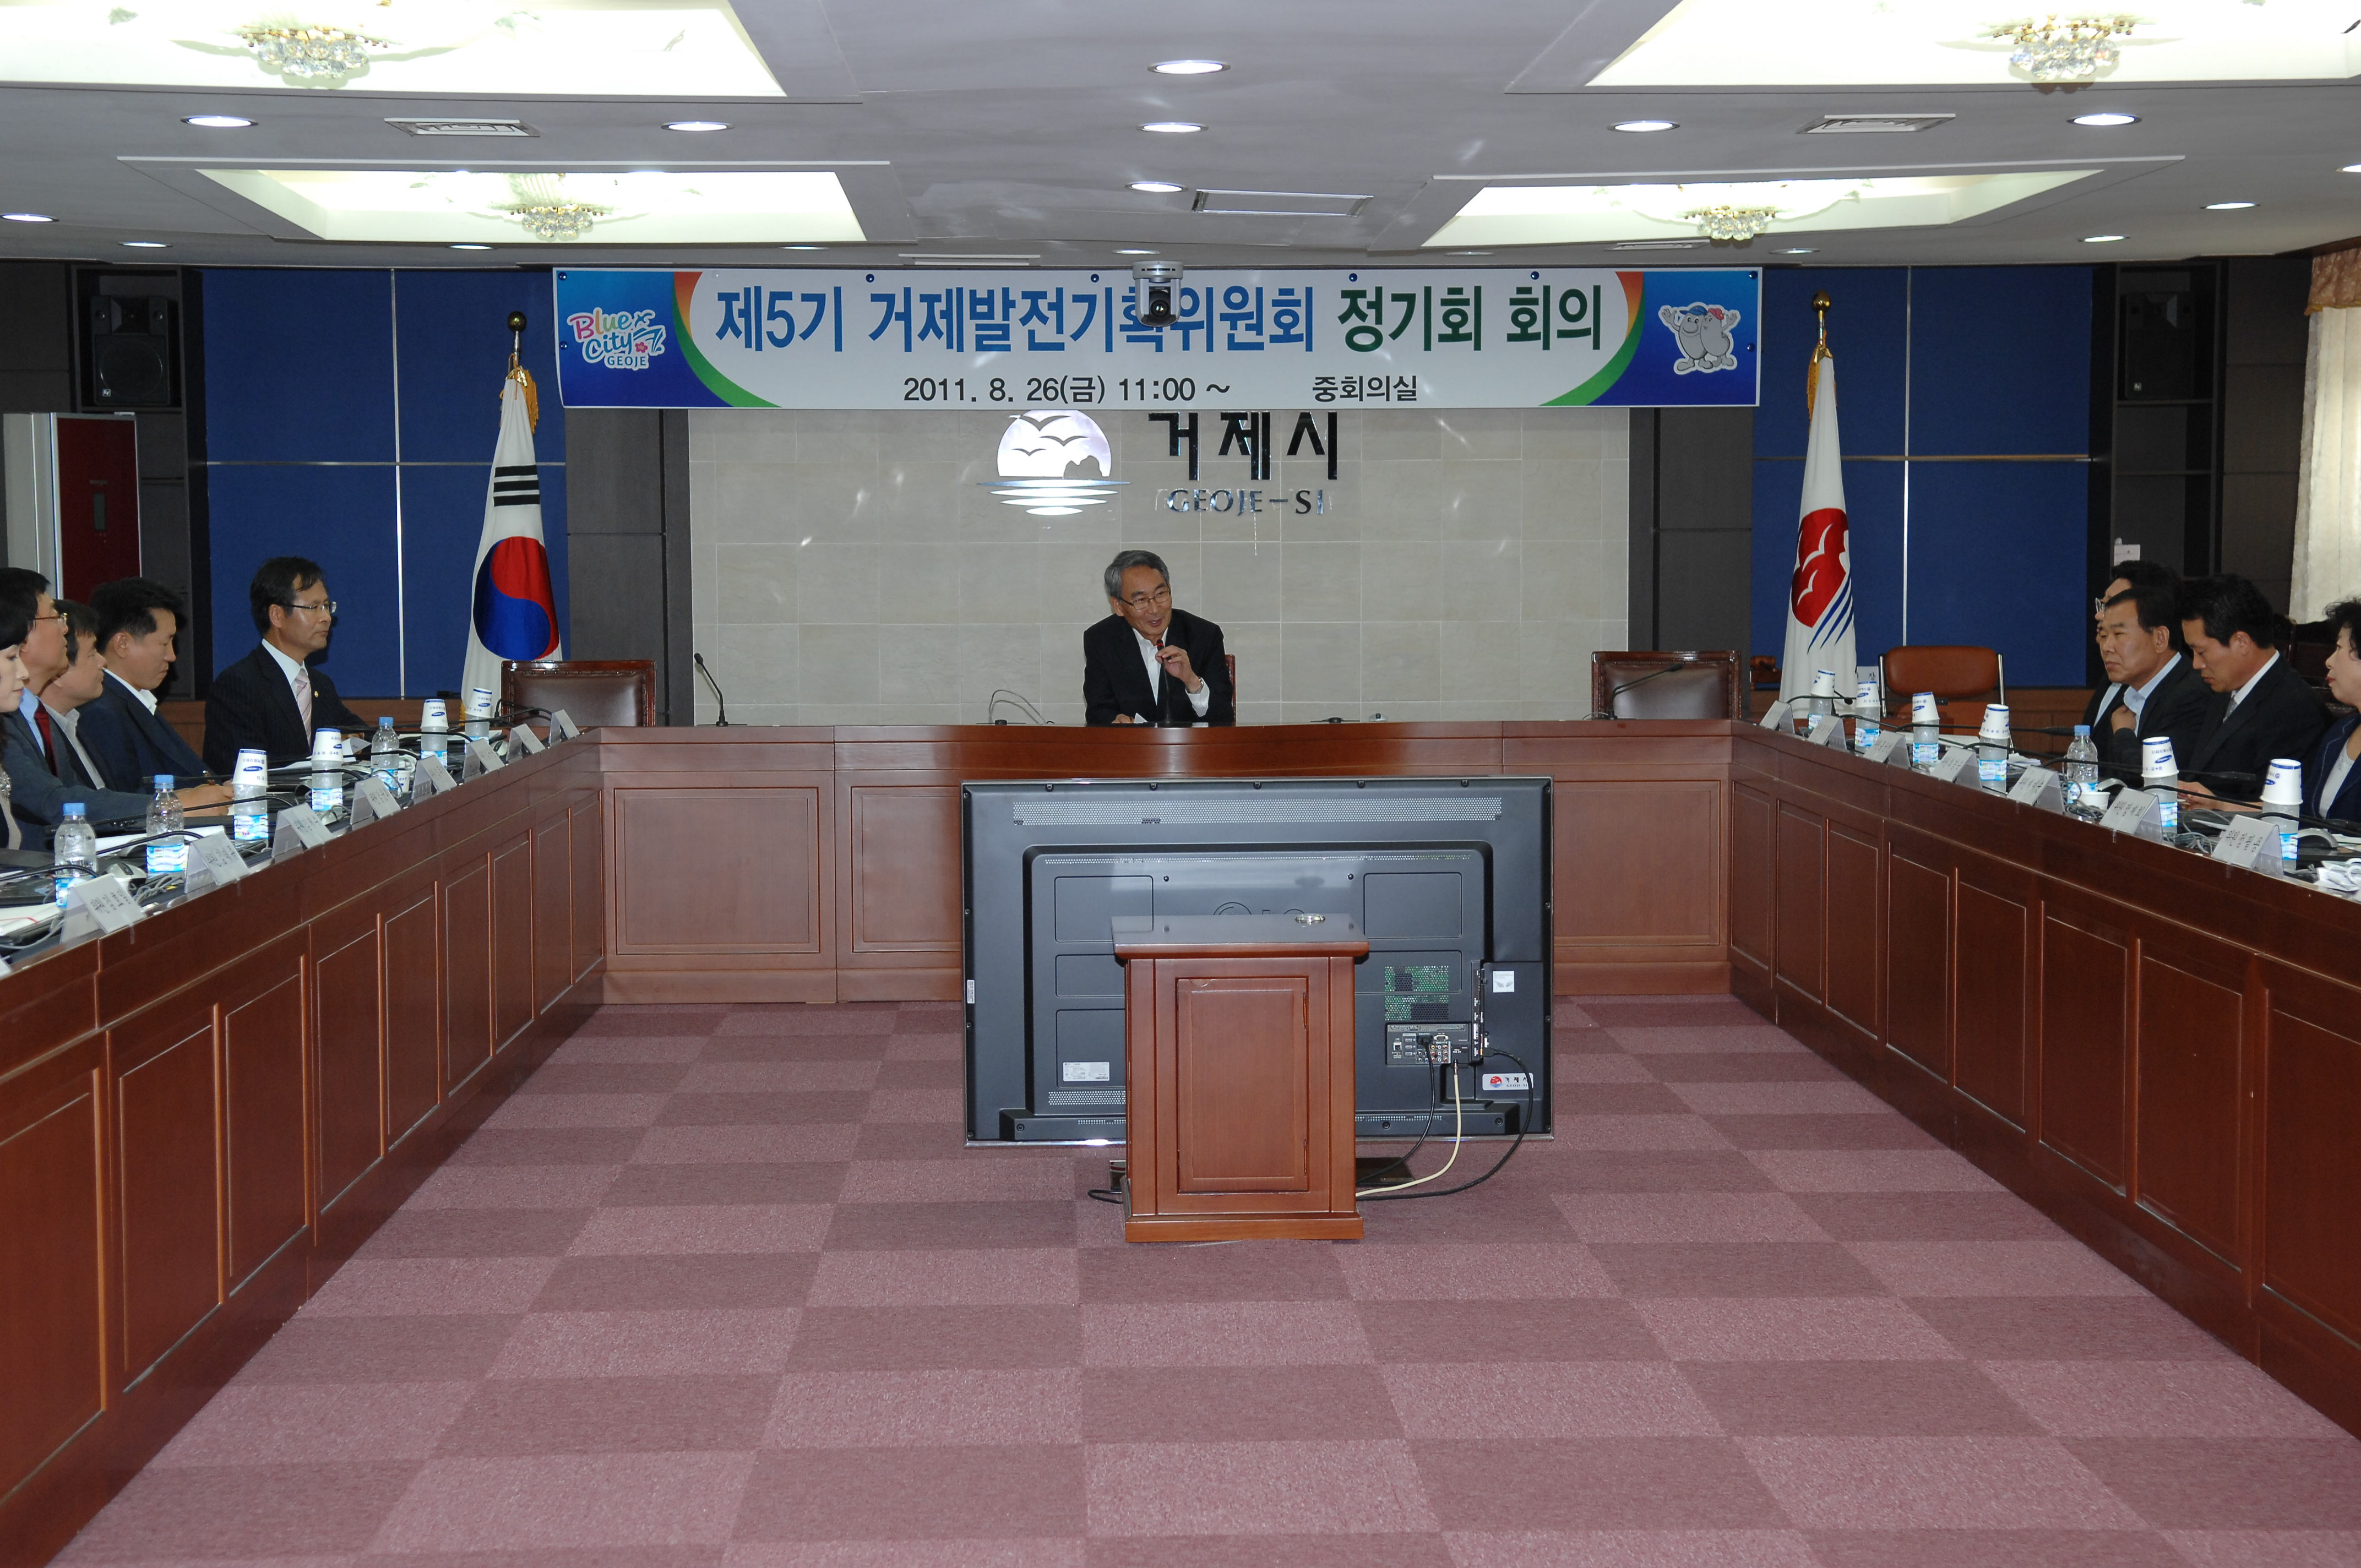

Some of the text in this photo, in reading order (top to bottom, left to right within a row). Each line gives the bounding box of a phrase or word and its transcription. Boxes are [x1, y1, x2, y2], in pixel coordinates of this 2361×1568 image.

[570, 310, 632, 340] Blue
[716, 286, 843, 352] 제5기
[1339, 283, 1482, 352] 정기회
[1507, 283, 1602, 351] 회의
[585, 331, 632, 360] City
[607, 356, 646, 368] GEOJE
[904, 378, 977, 402] 2011.
[989, 378, 1014, 402] 8.
[1026, 375, 1106, 404] 26(금)
[1119, 377, 1195, 401] 11:00
[1312, 375, 1417, 402] 중회의실
[1148, 411, 1337, 481] 거제시
